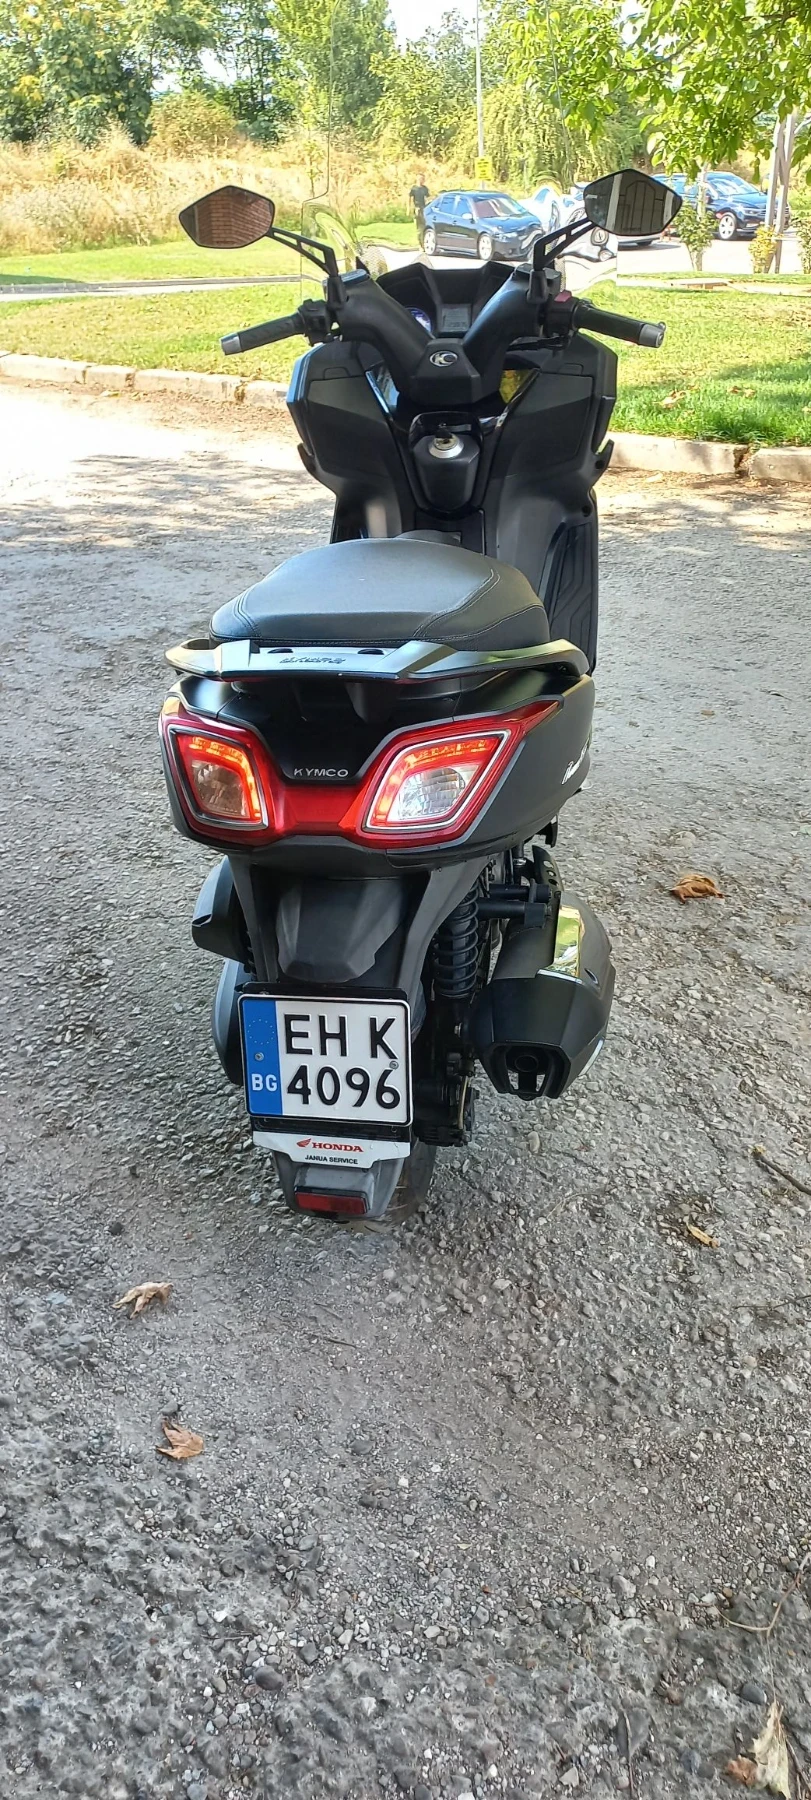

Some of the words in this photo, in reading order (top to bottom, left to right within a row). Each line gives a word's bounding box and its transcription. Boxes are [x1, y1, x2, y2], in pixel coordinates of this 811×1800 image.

[294, 768, 349, 777] KYMCO
[284, 1014, 347, 1057] EH
[370, 1016, 398, 1060] K
[251, 1073, 278, 1092] BG
[287, 1065, 401, 1110] 4096
[312, 1142, 364, 1152] HONDA
[329, 1156, 358, 1164] SERVICE
